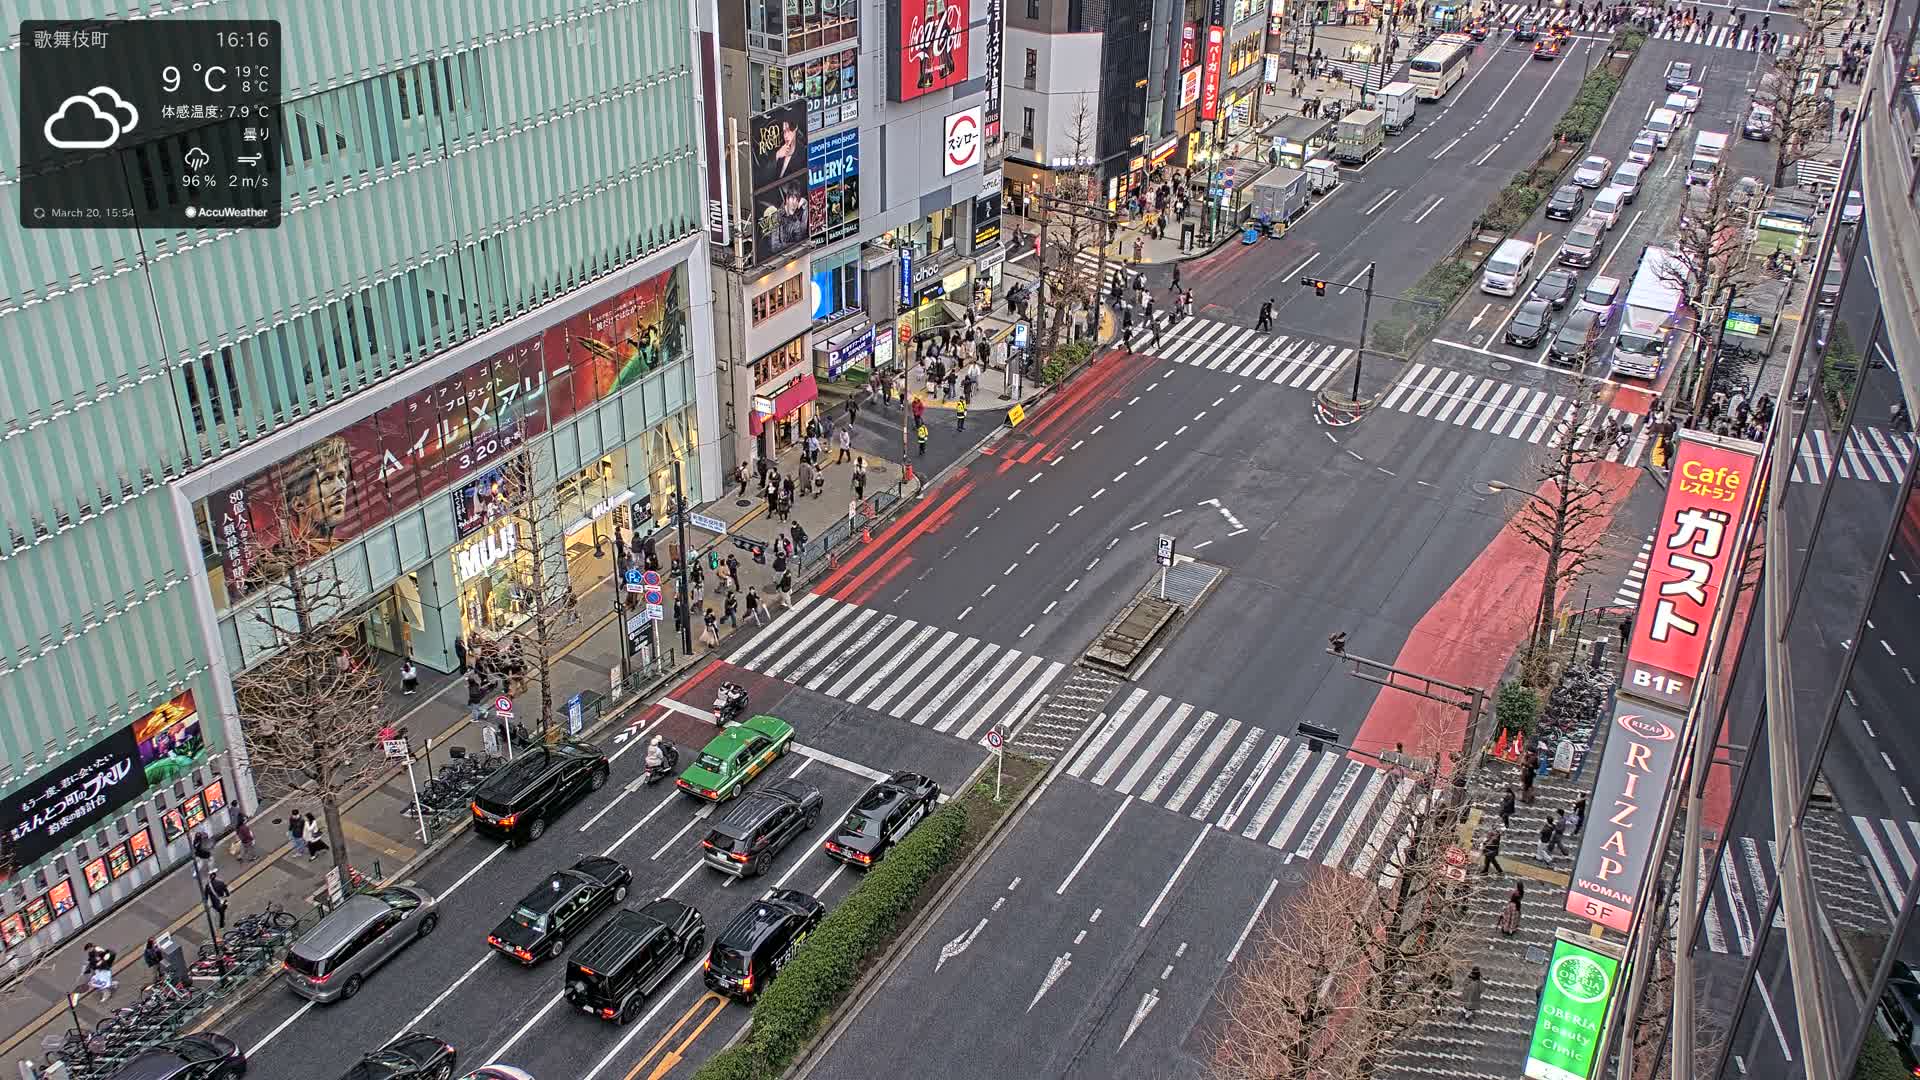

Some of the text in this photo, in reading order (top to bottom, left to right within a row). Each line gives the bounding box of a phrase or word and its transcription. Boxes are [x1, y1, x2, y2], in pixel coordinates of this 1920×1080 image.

[1205, 45, 1219, 110] バーガーキング
[947, 132, 979, 151] スシロー
[709, 199, 722, 232] MUJI
[902, 249, 910, 258] P
[1017, 326, 1025, 335] P
[830, 351, 840, 367] P
[410, 341, 541, 413] ライアン・ゴズリング
[445, 377, 504, 412] プロジェクト
[459, 440, 498, 470] 3.20
[1682, 460, 1741, 489] Café
[1679, 479, 1737, 502] レストラン
[592, 498, 615, 519] MUJI
[458, 522, 516, 583] MUJI
[1161, 540, 1168, 549] P
[629, 573, 636, 581] P
[1649, 507, 1730, 643] ガスト
[1632, 669, 1684, 695] B1F
[1632, 719, 1663, 735] RIZAP
[22, 753, 114, 812] もう一度、君に会いたい
[1596, 741, 1652, 881] RIZAP
[1577, 878, 1633, 905] WOMAN
[1585, 901, 1614, 920] 5F
[1559, 970, 1600, 991] OBERIA
[1543, 1004, 1598, 1032] OBERIA
[1543, 1019, 1590, 1046] Beauty
[1542, 1039, 1584, 1062] Clinic
